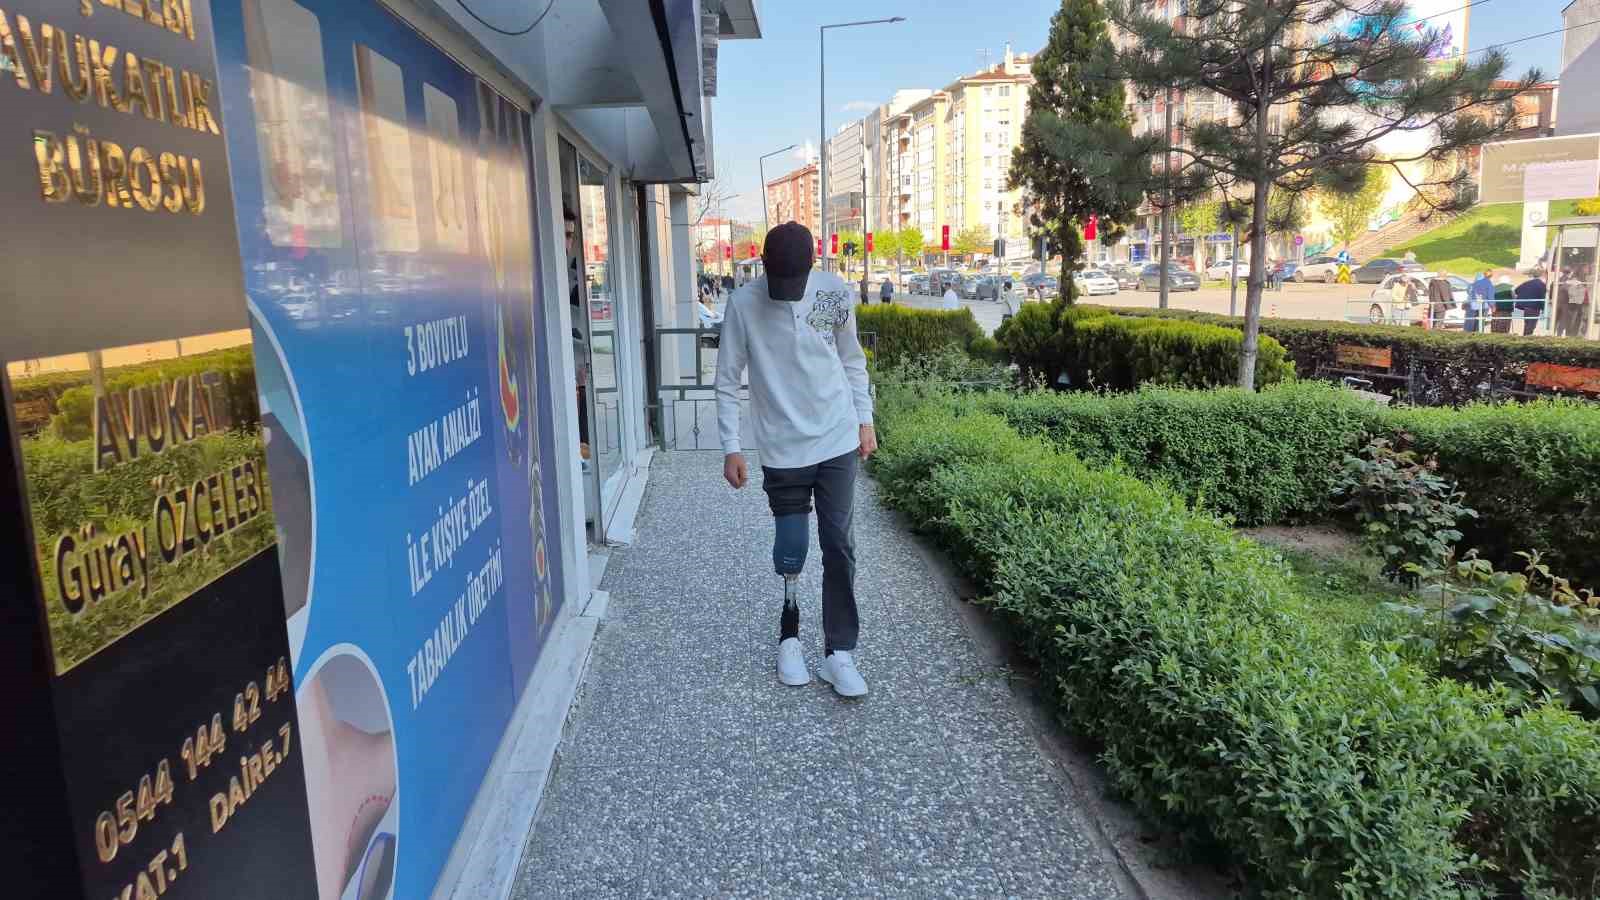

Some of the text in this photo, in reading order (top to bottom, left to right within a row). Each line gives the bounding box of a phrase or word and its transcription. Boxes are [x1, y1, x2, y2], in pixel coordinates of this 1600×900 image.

[33, 121, 205, 216] BÜROSU
[404, 315, 469, 376] 3 BOYUTLU
[93, 372, 226, 473] AVUKAT
[407, 385, 482, 487] AYAK ANALİZİ
[56, 521, 150, 614] Güray
[407, 477, 493, 597] İLE KİŞİYE ÖZEL
[407, 537, 504, 711] TABANLIK ÜRETİMİ
[95, 656, 290, 863] 0544 144 42 44
[112, 721, 291, 900] AT.1 DAİRE.7
